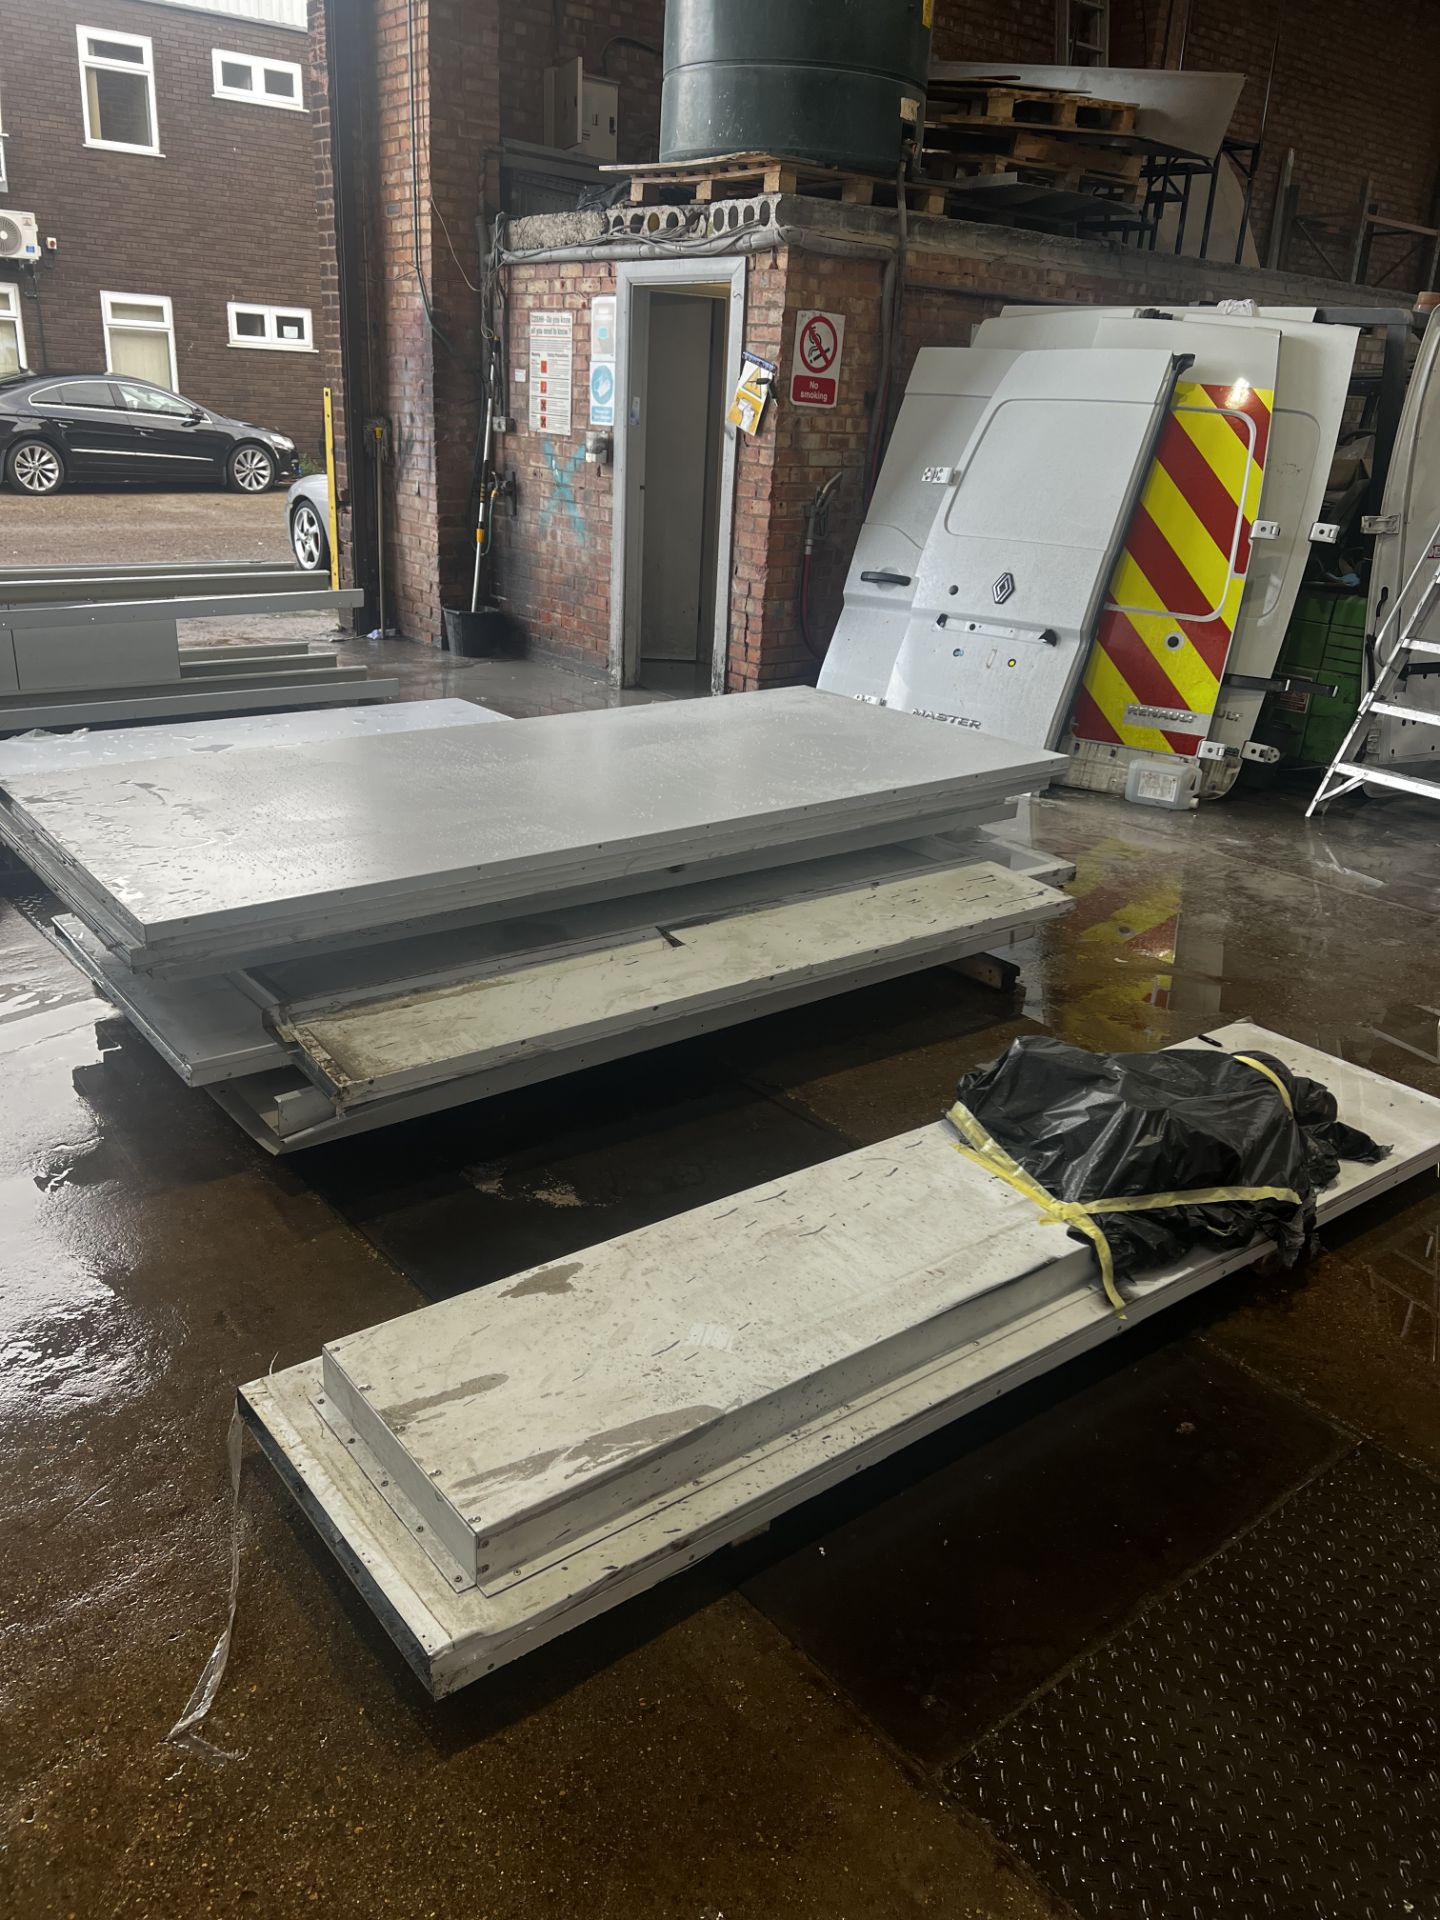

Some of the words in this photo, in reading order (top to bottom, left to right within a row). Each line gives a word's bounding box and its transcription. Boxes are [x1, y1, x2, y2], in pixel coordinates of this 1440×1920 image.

[809, 380, 819, 389] No
[800, 391, 828, 402] smoking
[912, 708, 982, 730] MASTER
[1127, 705, 1198, 724] RENAULT
